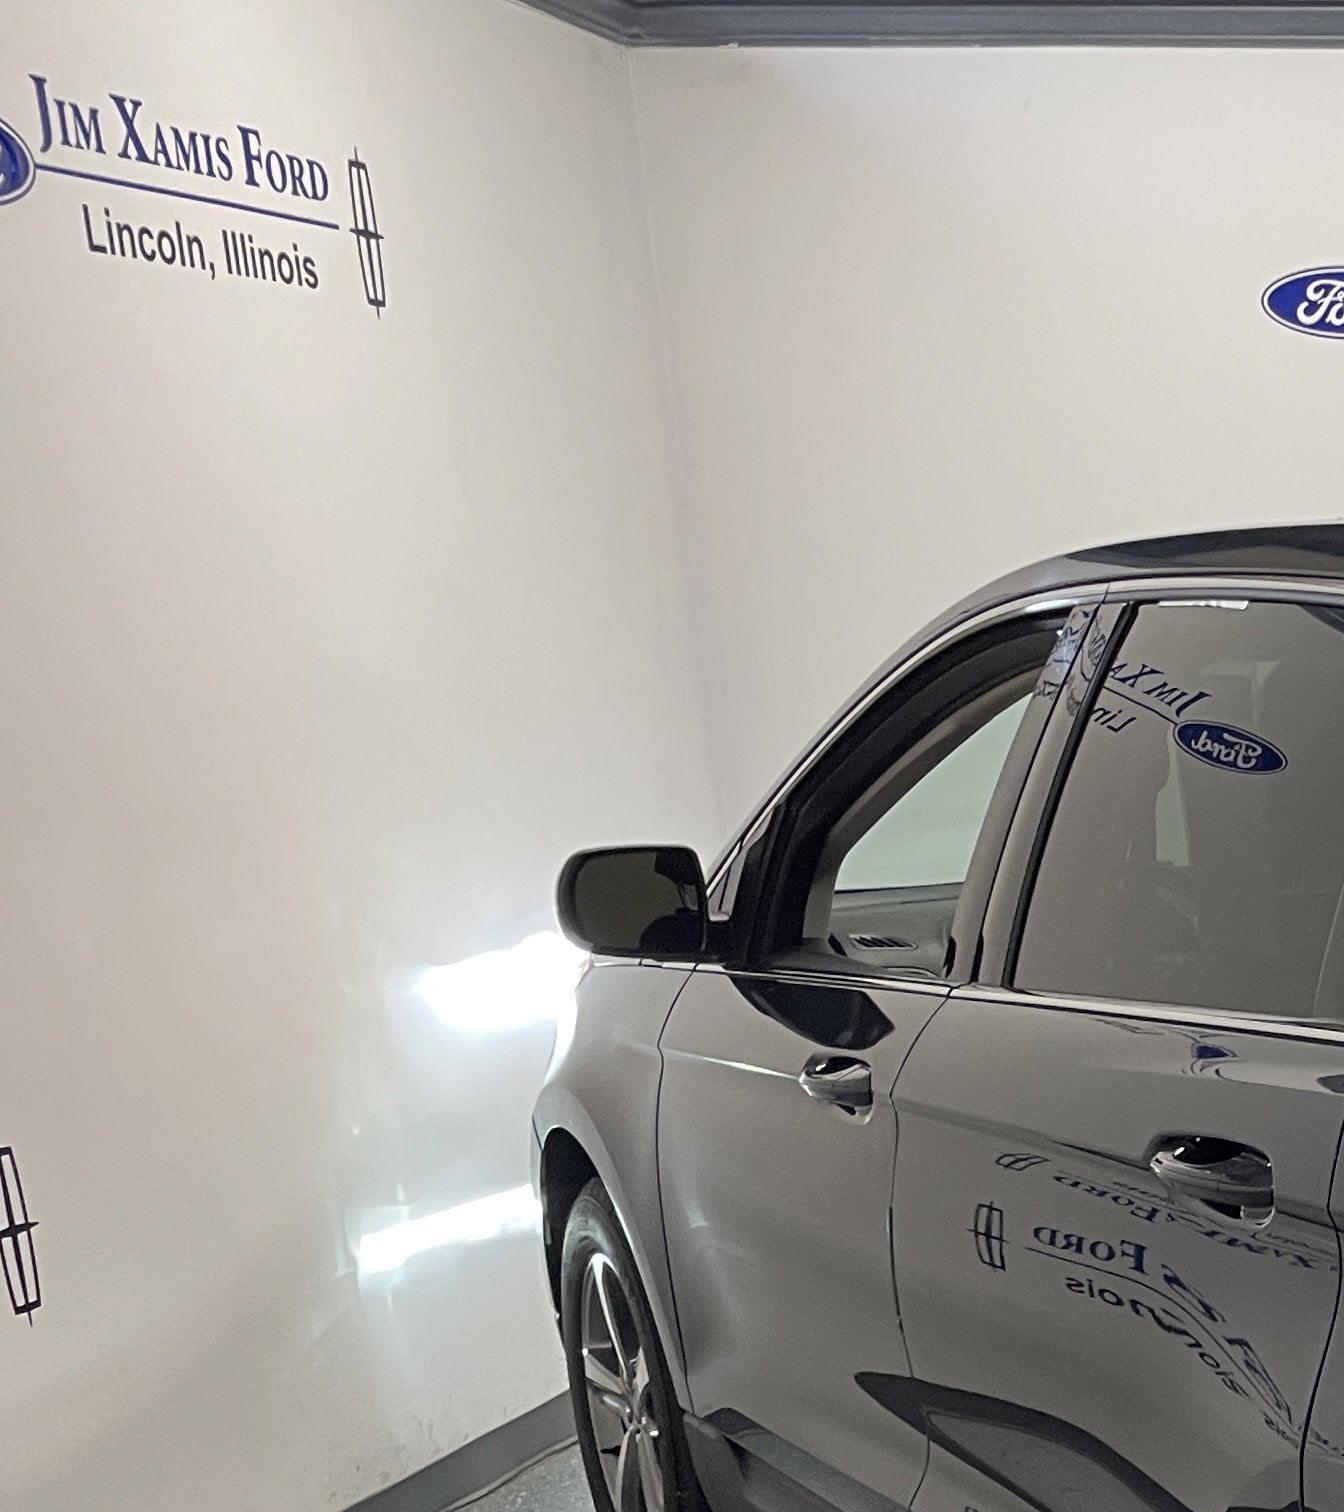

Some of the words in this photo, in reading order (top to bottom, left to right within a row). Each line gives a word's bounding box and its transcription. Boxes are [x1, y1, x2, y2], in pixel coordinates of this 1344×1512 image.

[28, 72, 106, 154] JIM
[108, 92, 234, 182] XAMIS
[236, 124, 330, 201] FORD
[82, 203, 216, 281] Lincoln,
[221, 228, 320, 290] Illinois
